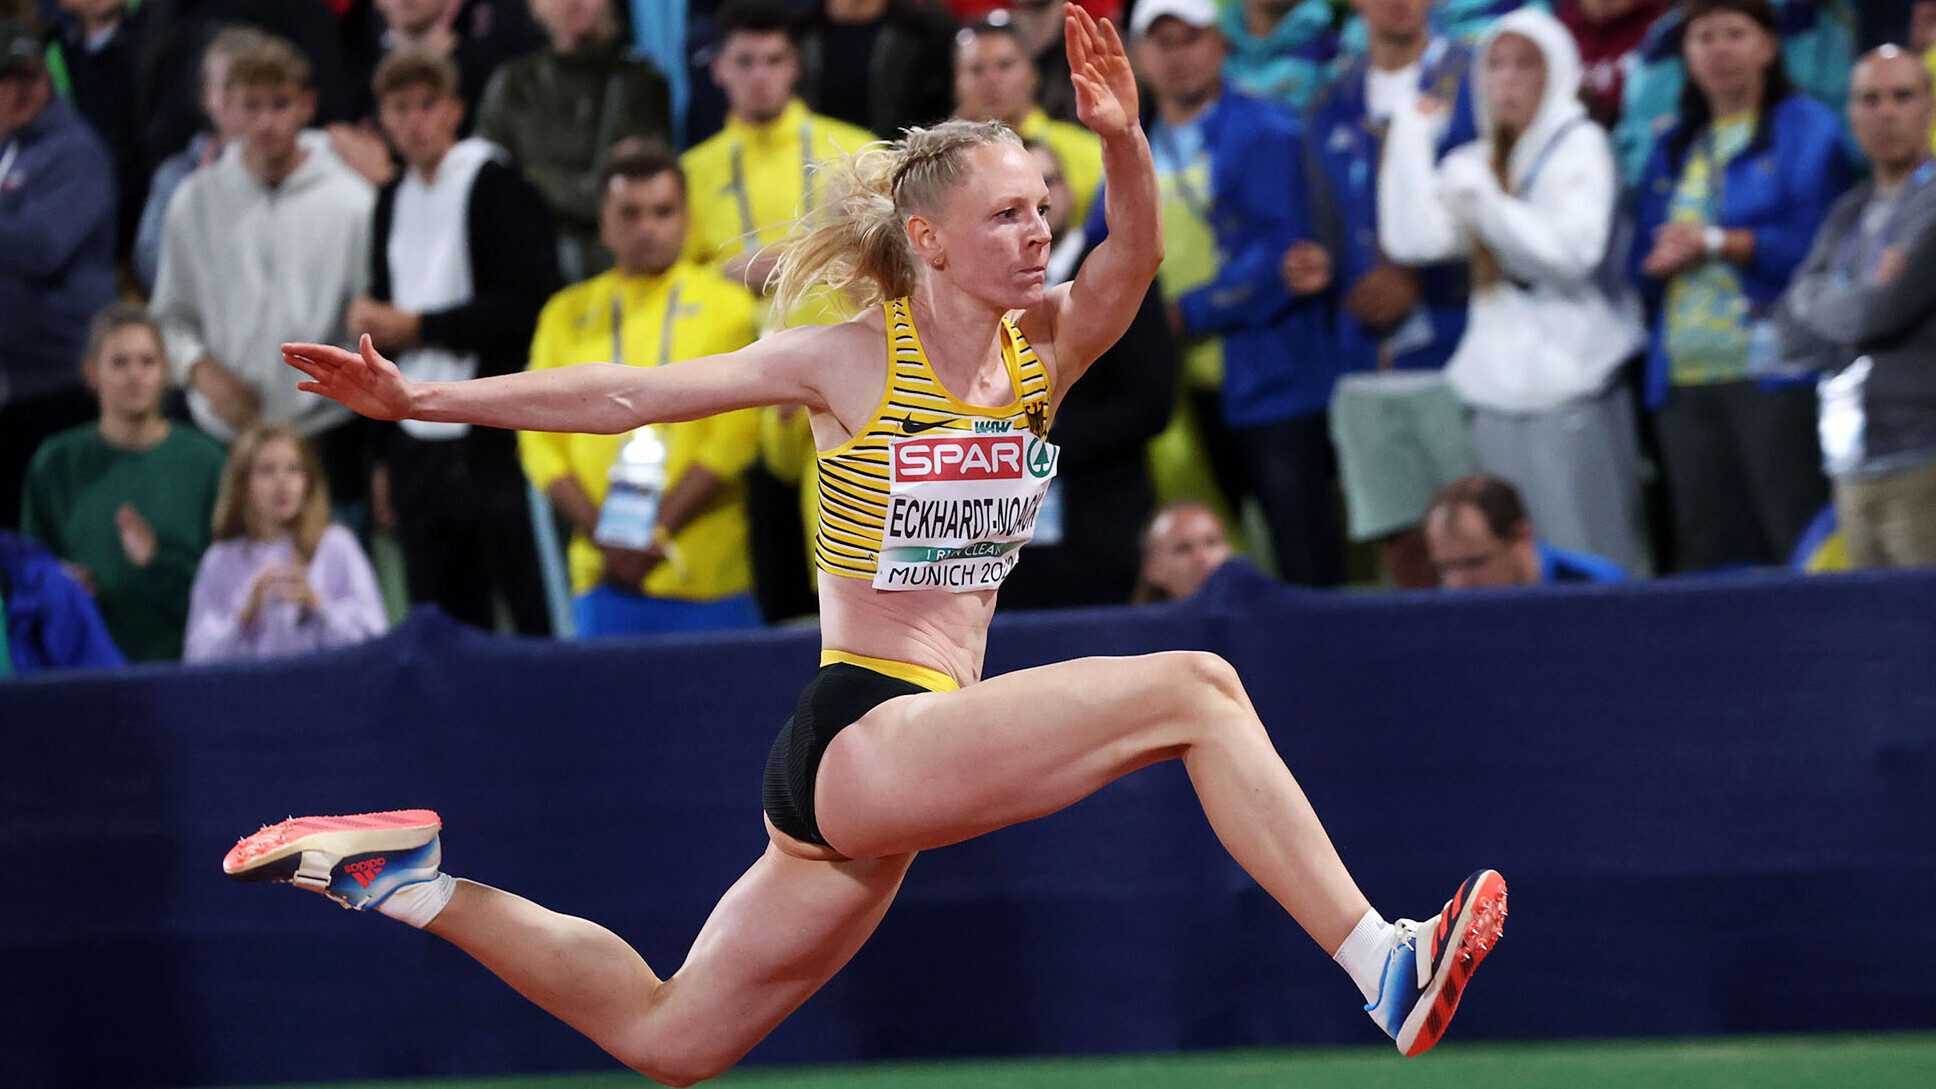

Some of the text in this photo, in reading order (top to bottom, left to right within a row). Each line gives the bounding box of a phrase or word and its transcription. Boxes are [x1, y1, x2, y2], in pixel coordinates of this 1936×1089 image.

[899, 442, 1020, 476] SPAR
[926, 549, 932, 560] I
[888, 564, 975, 586] MUNICH
[343, 857, 386, 873] adidas
